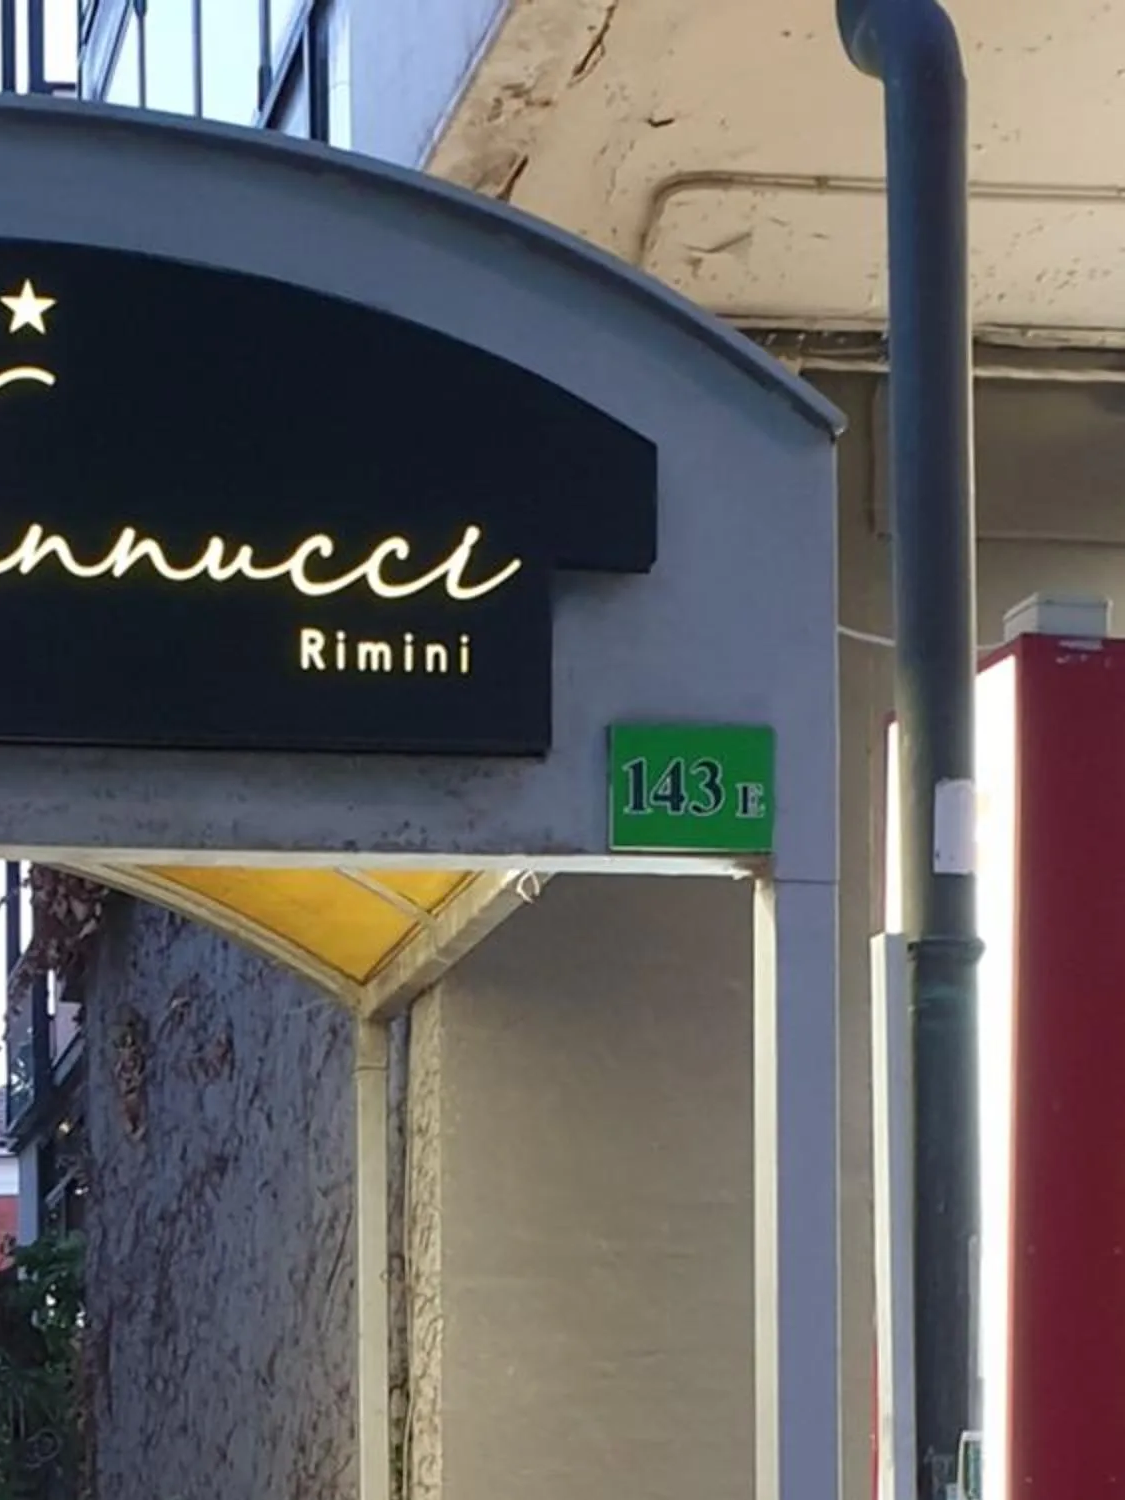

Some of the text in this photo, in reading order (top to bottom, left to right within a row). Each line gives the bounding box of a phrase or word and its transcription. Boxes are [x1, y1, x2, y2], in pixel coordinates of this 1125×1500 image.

[299, 627, 471, 675] Rimini
[622, 757, 766, 818] 143 E
